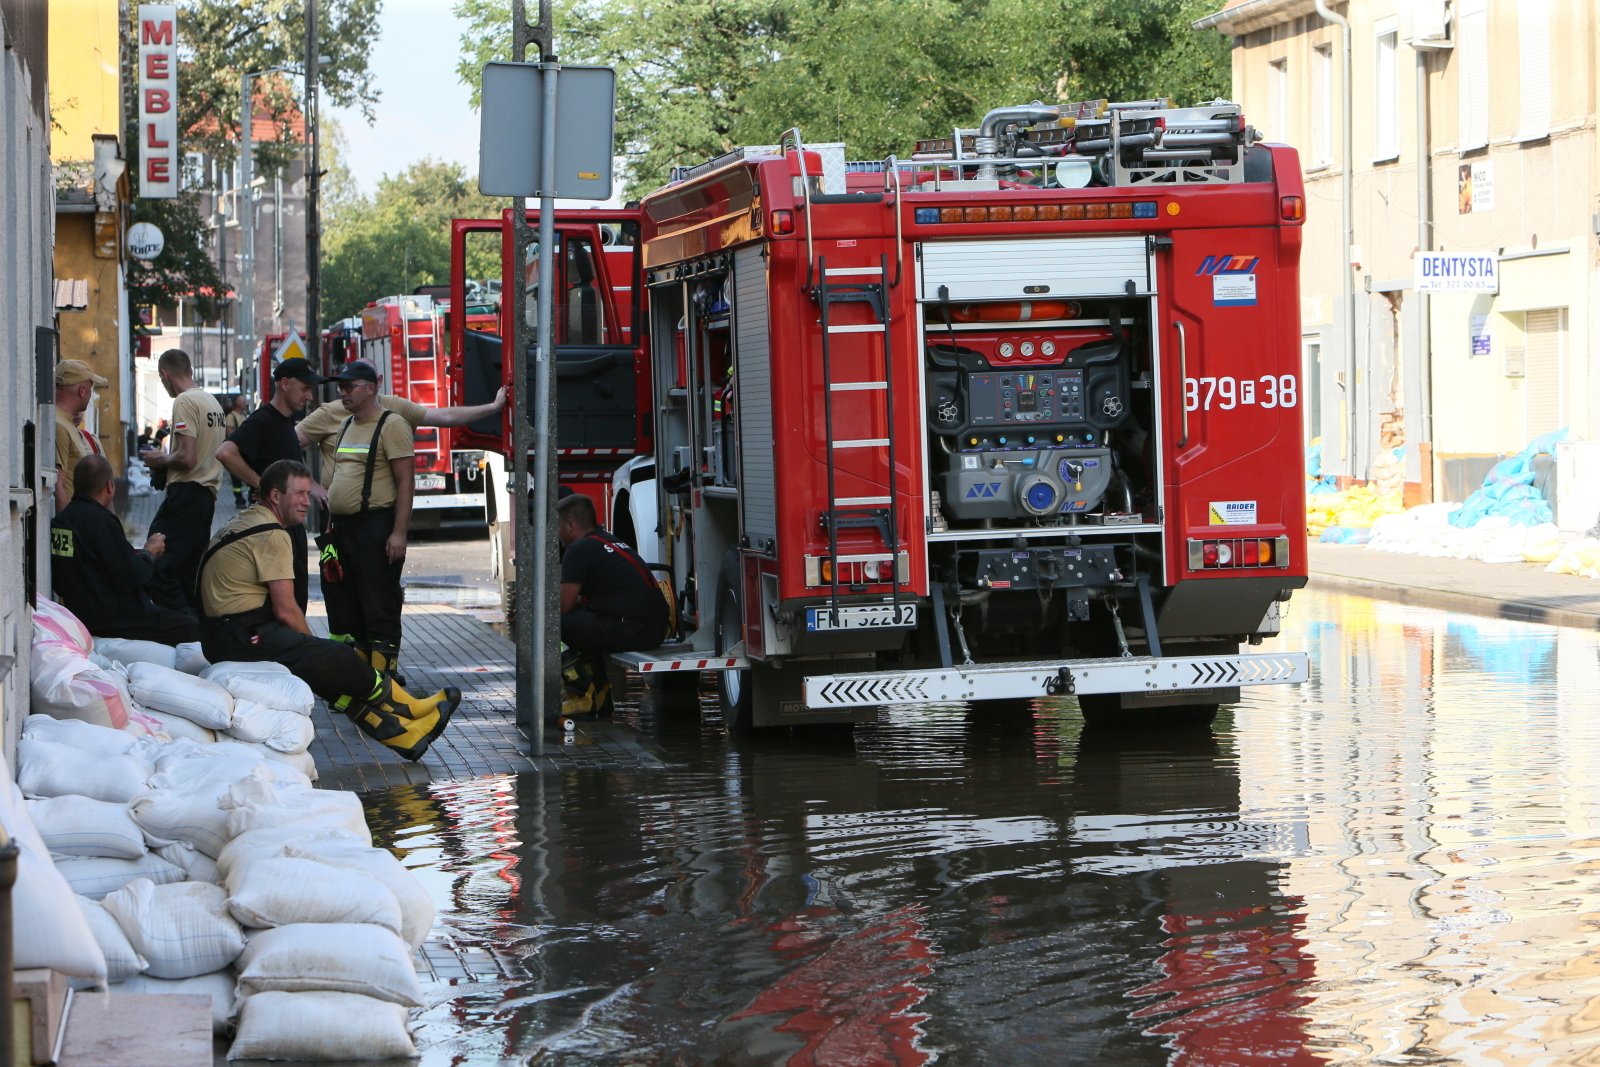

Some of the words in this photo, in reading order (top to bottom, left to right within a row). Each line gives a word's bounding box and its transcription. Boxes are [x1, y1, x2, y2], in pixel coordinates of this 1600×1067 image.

[142, 19, 173, 183] MEBLE
[130, 243, 160, 255] FORTE
[1422, 257, 1494, 277] DENTYSTA
[1463, 280, 1474, 289] 00
[1241, 380, 1255, 404] F
[1259, 374, 1297, 409] 38
